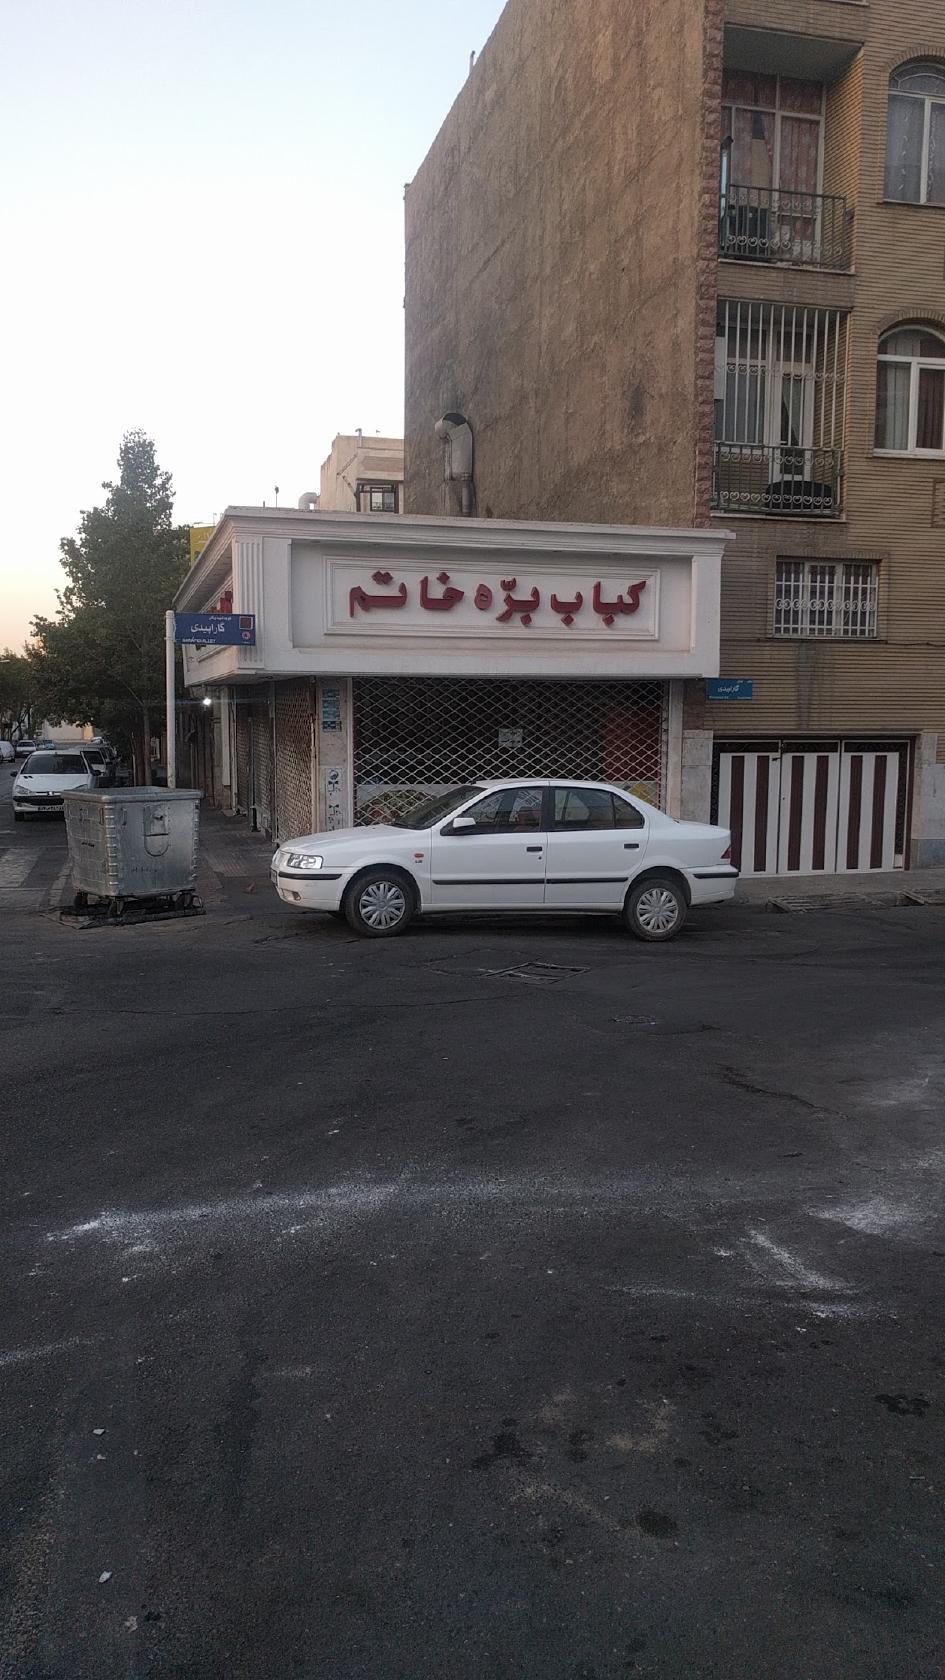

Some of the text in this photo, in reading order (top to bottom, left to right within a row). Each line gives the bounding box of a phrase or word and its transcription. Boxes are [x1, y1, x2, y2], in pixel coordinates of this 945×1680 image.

[349, 570, 465, 618] خاتم
[551, 580, 647, 627] کباب
[190, 622, 225, 634] گاراپیدی
